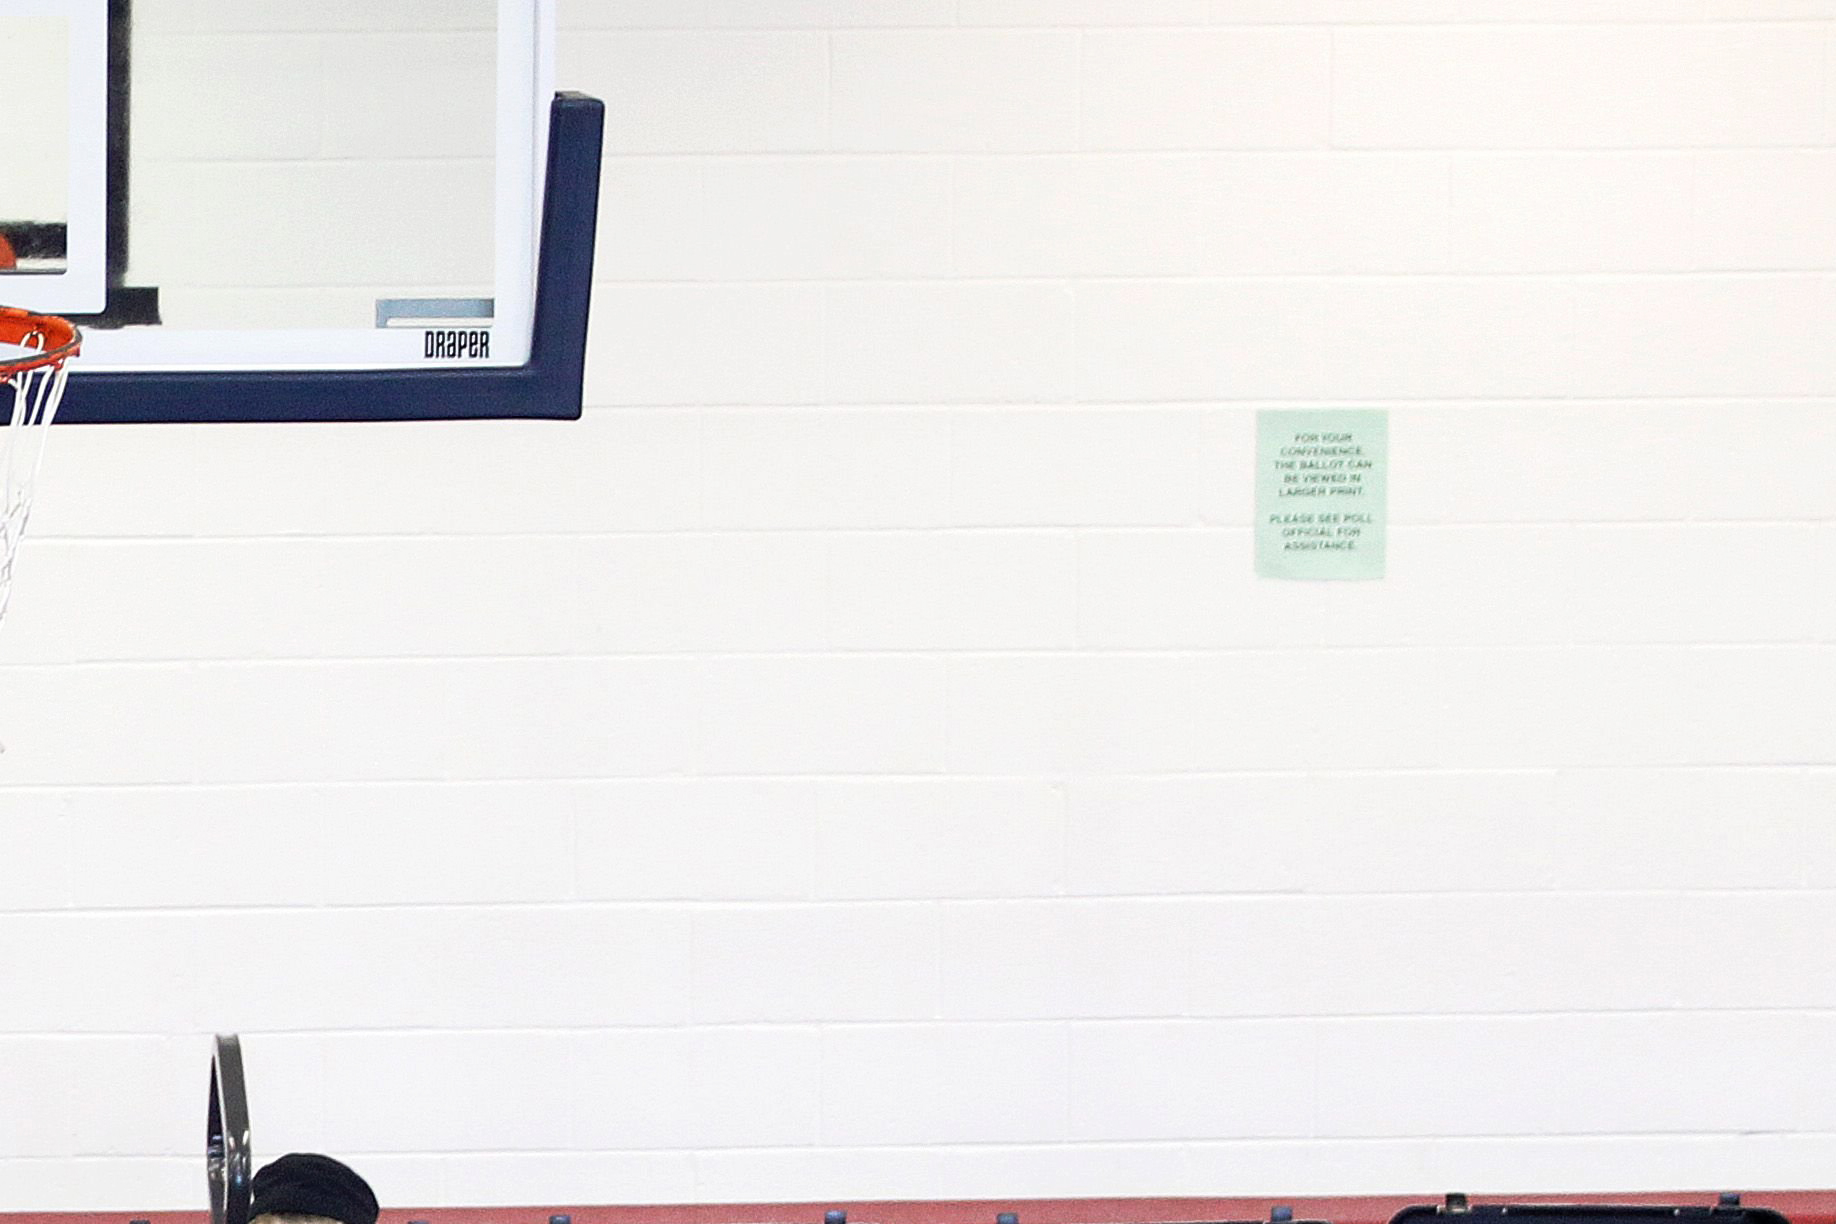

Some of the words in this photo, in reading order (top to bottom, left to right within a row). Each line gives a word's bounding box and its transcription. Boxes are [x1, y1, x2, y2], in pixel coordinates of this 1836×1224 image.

[1294, 433, 1319, 442] FOR
[1321, 433, 1352, 442] YOUR
[1275, 460, 1295, 469] THE
[1299, 460, 1344, 470] BALLOT
[1348, 460, 1372, 469] CAN
[1284, 474, 1298, 483] BE
[1304, 473, 1346, 483] VIEWED
[1350, 473, 1361, 482] IN
[1278, 487, 1326, 497] LARGER
[1269, 514, 1314, 524] PLEASE
[1318, 514, 1340, 523] SEE
[1343, 514, 1372, 524] POLL
[1281, 527, 1332, 537] OFFICIAL
[1336, 527, 1361, 537] FOR
